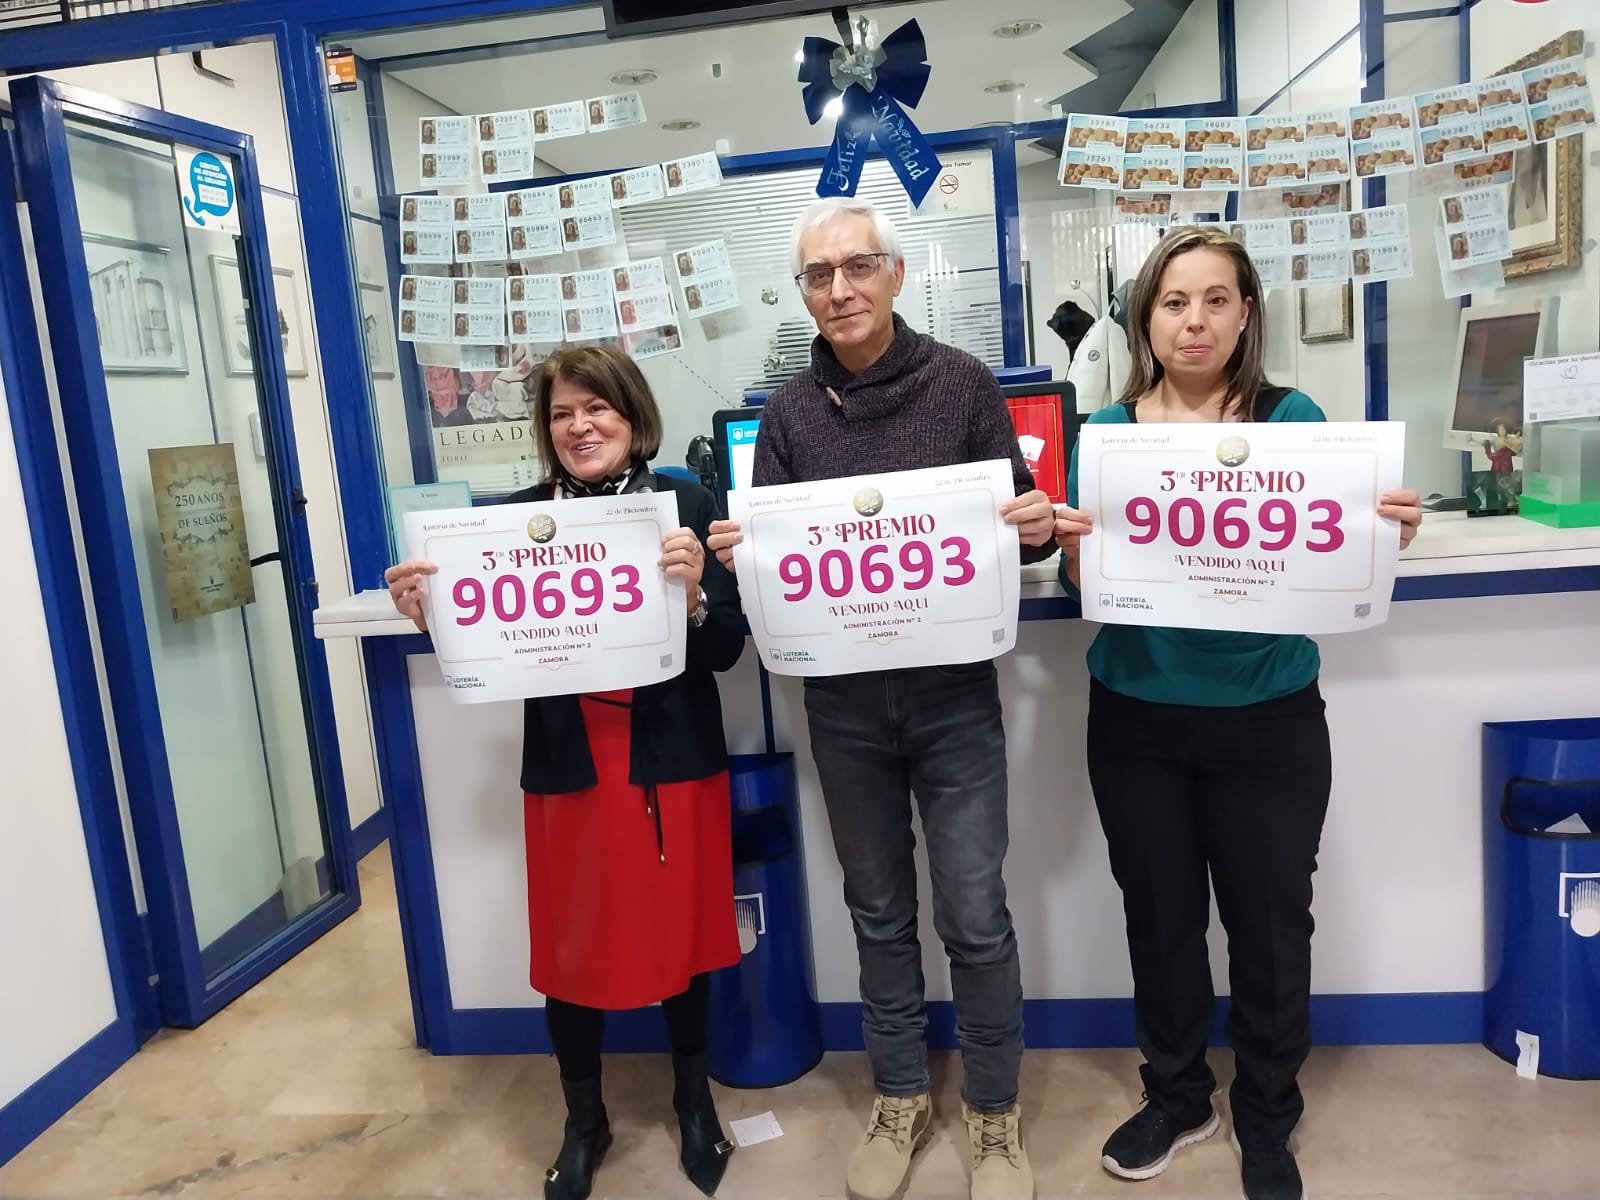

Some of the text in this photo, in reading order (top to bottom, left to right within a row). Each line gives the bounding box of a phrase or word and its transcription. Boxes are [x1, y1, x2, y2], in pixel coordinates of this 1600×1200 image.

[827, 96, 930, 191] Feliz Navidad
[1190, 470, 1305, 493] PREMIO
[175, 492, 225, 507] 250 AÑOS
[178, 513, 228, 529] DE SUEÑOS
[834, 513, 936, 543] PREMIO
[1125, 496, 1345, 553] 90693
[509, 542, 607, 568] PREMIO
[778, 536, 976, 602] 90693
[1174, 554, 1286, 574] VENDIDO AQUÍ
[1188, 574, 1257, 584] ADMINISTRACIÓN
[452, 564, 644, 626] 90693
[1115, 595, 1146, 604] LOTERÍA
[1213, 588, 1248, 597] ZAMORA
[828, 597, 929, 617] VENDIDO AQUÍ
[1115, 602, 1154, 610] NACIONAL
[500, 620, 600, 641] VENDIDO AQUÍ
[843, 617, 905, 630] ADMINISTRACIÓN
[868, 630, 899, 639] ZAMORA
[514, 642, 576, 655] ADMINISTRACIÓN
[783, 649, 809, 657] LOTERÍA
[538, 656, 569, 664] ZAMORA
[454, 681, 486, 689] NACIONAL
